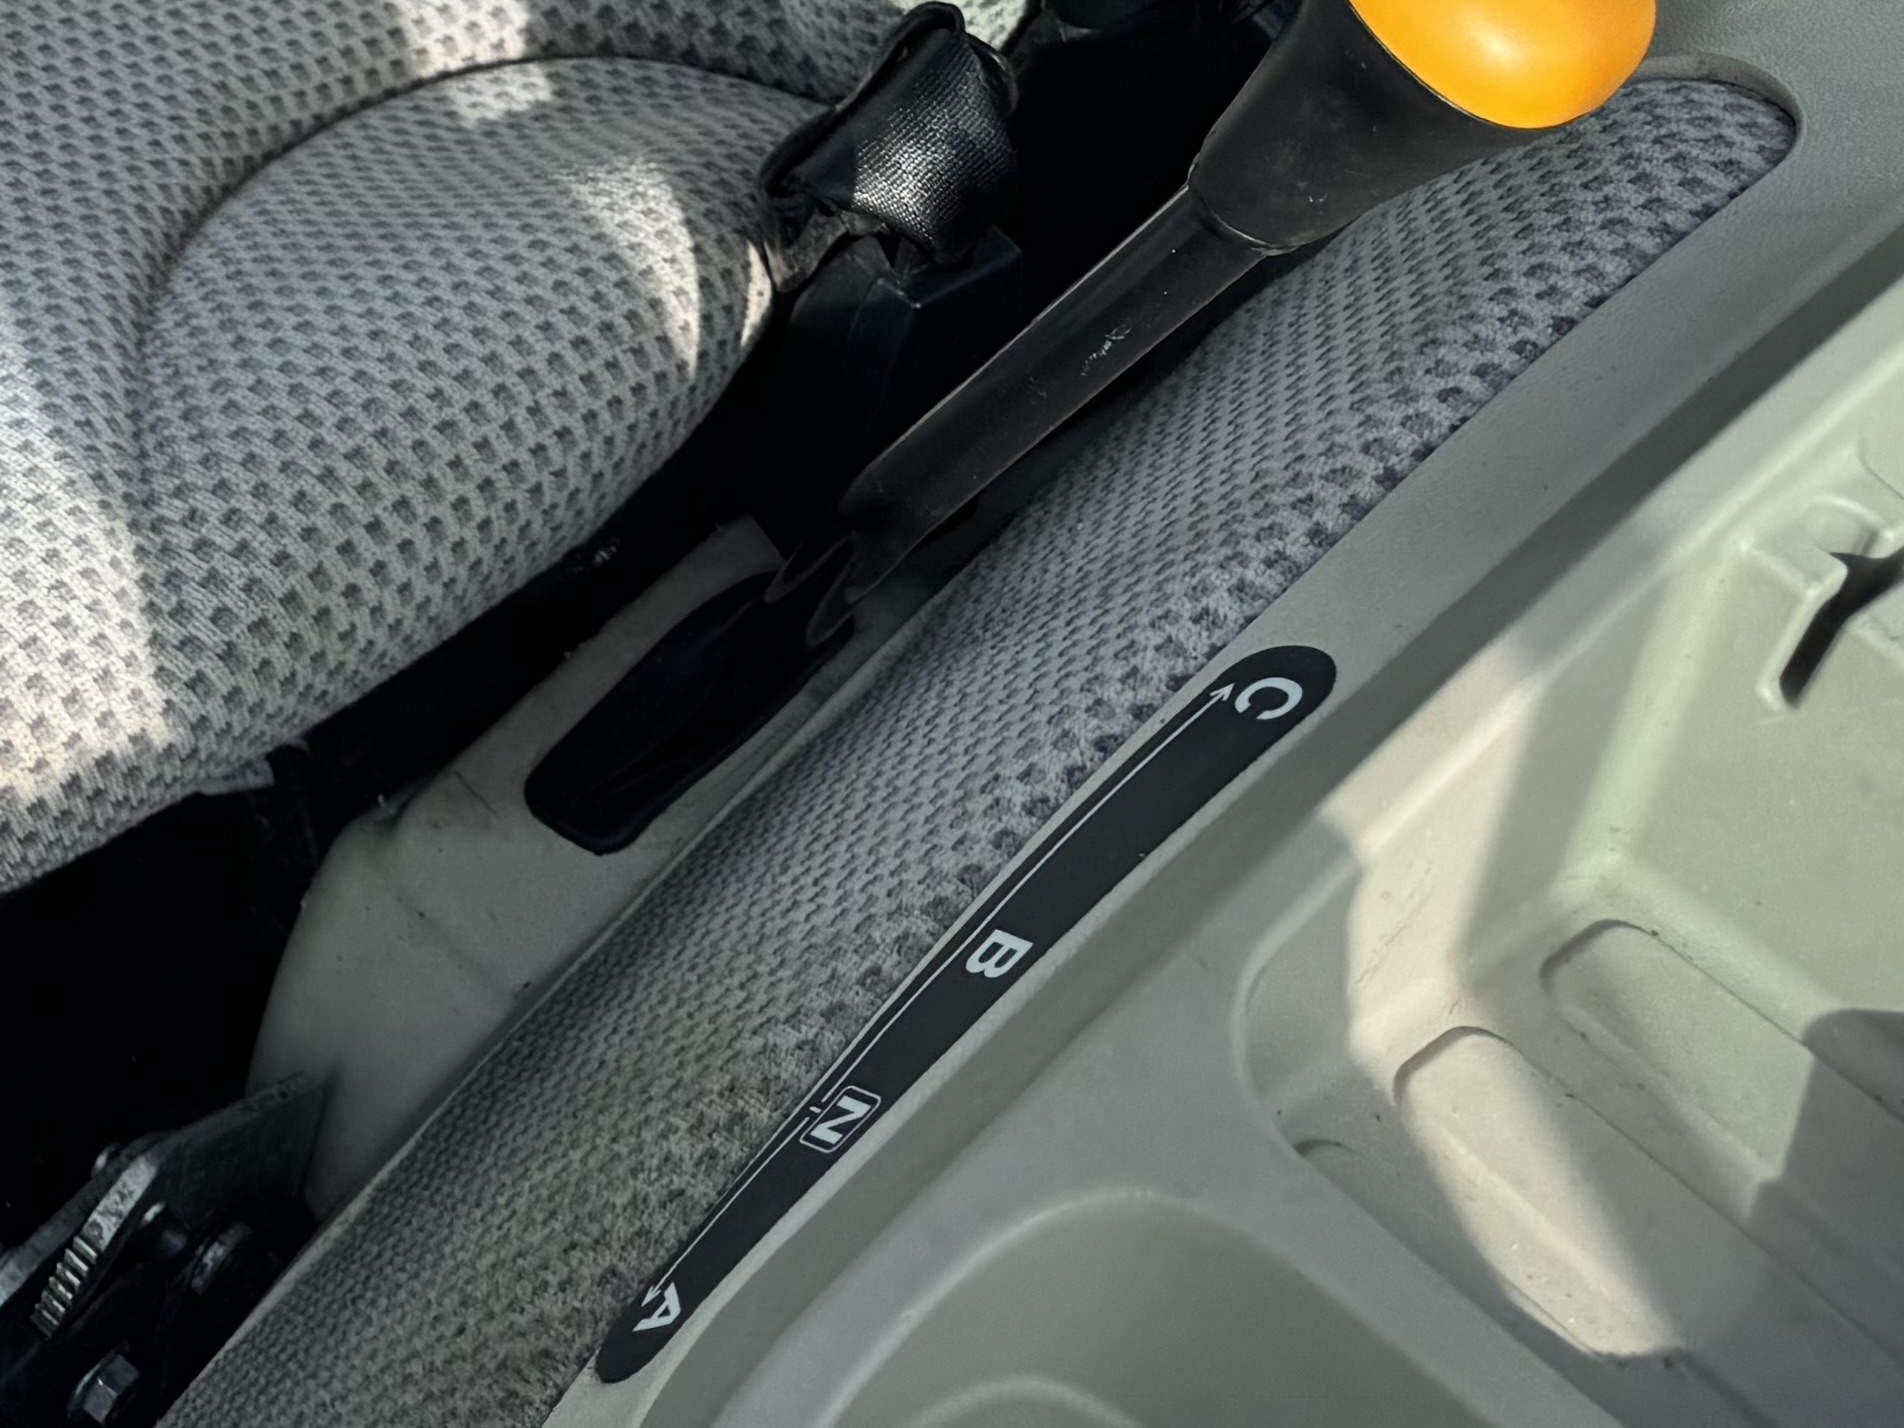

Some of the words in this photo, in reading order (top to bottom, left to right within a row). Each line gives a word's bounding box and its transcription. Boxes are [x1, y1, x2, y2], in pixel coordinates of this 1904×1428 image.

[1234, 675, 1302, 722] C
[965, 928, 1033, 978] B
[810, 1096, 872, 1144] N
[633, 1282, 682, 1332] A
